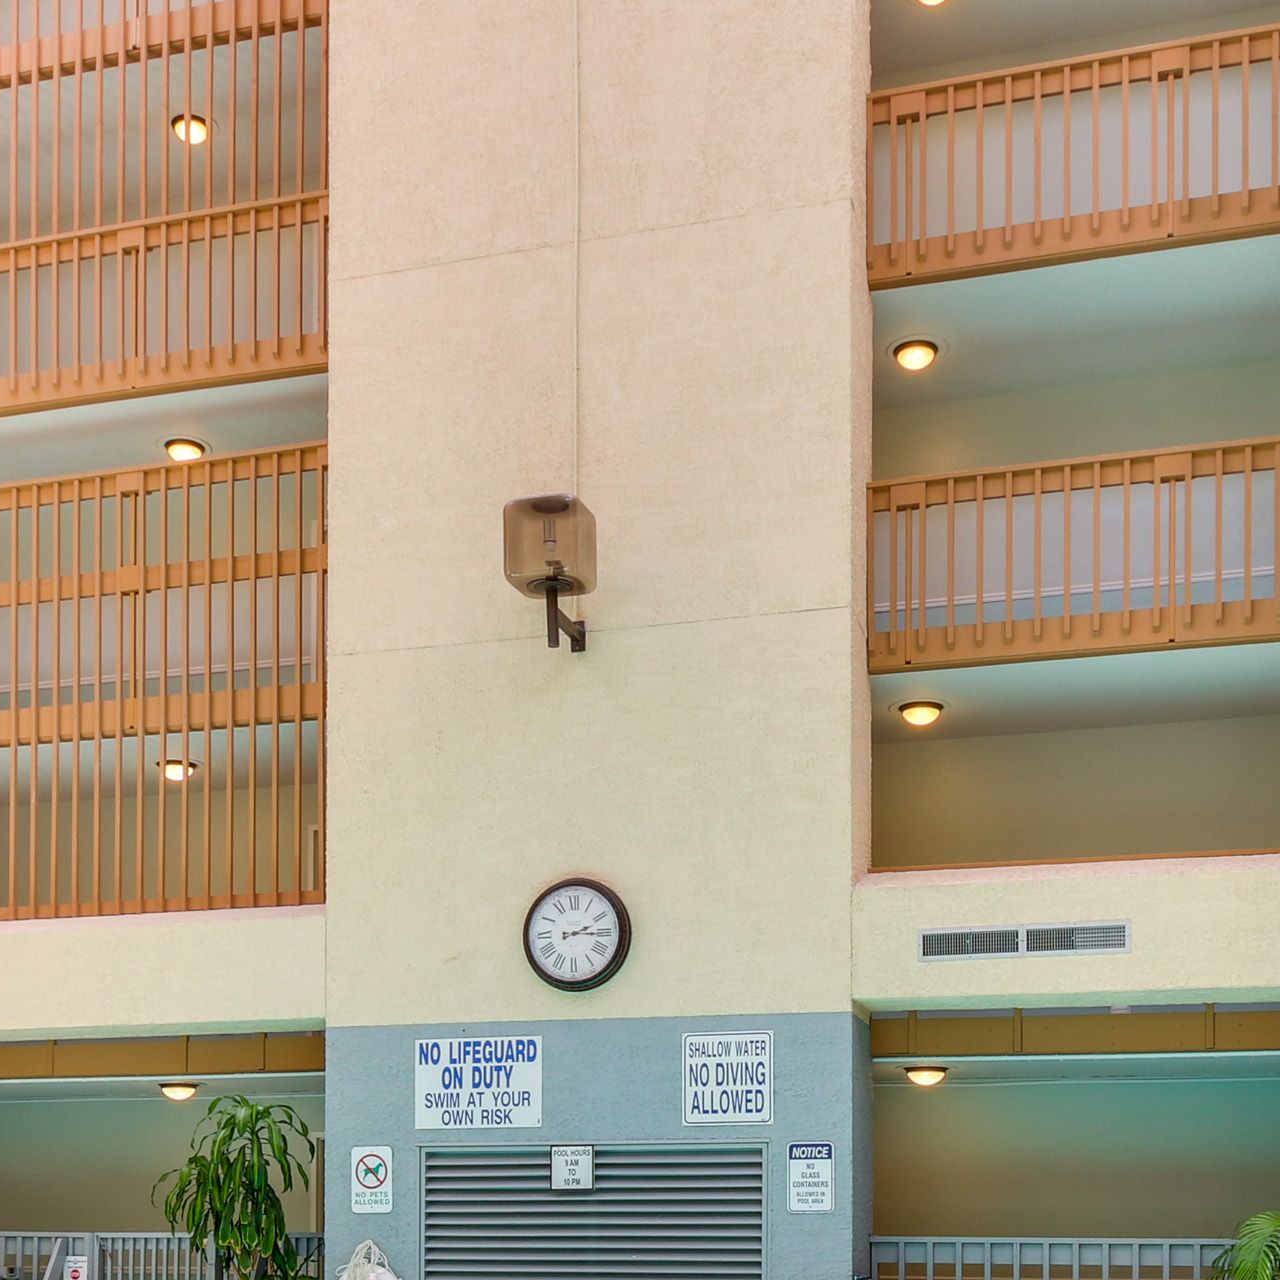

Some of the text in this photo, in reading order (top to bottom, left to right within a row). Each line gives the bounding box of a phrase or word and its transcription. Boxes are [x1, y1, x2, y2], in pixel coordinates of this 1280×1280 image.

[419, 1039, 538, 1065] NO LIFEGUARD
[688, 1040, 767, 1058] SHALLOW WATER
[441, 1065, 514, 1090] ON DUTY
[689, 1061, 766, 1087] NO DIVING
[425, 1091, 531, 1109] SWIM AT YOUR
[691, 1089, 765, 1114] ALLOWED
[441, 1109, 513, 1125] OWN RISK
[791, 1147, 829, 1158] NOTICE
[568, 1168, 576, 1176] TO
[563, 1178, 581, 1186] 10 PM
